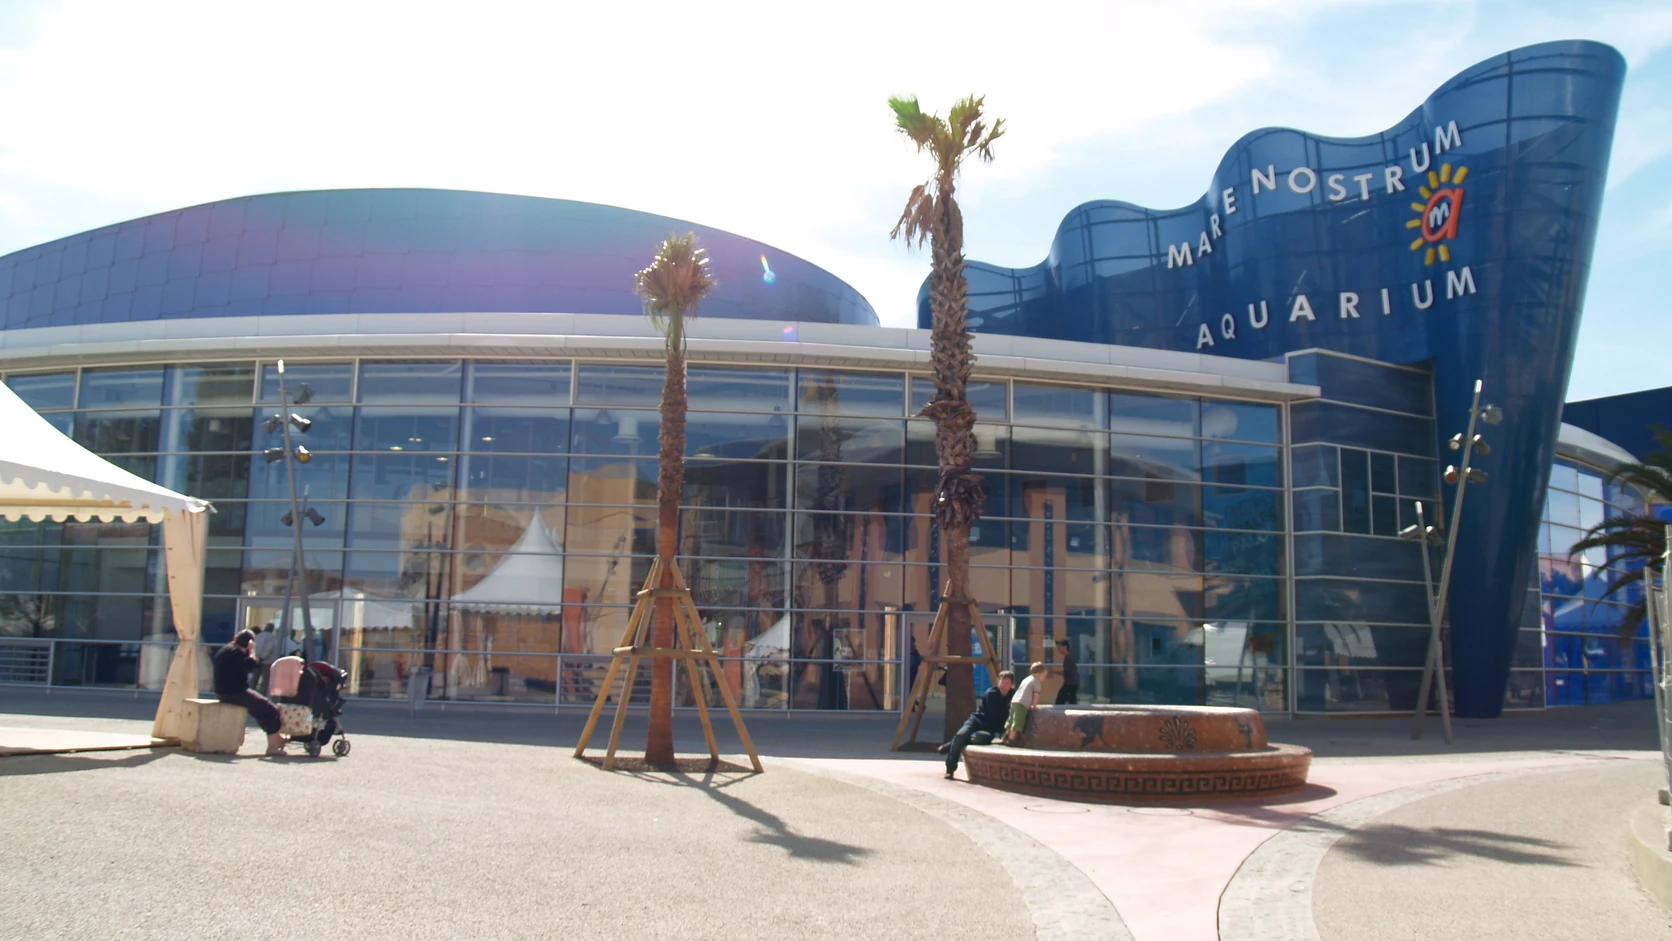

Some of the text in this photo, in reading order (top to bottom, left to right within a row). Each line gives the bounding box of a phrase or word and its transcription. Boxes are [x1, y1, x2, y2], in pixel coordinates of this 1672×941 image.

[1167, 120, 1462, 269] MARE NOSTRUM
[1197, 266, 1477, 349] AQUARIUM
